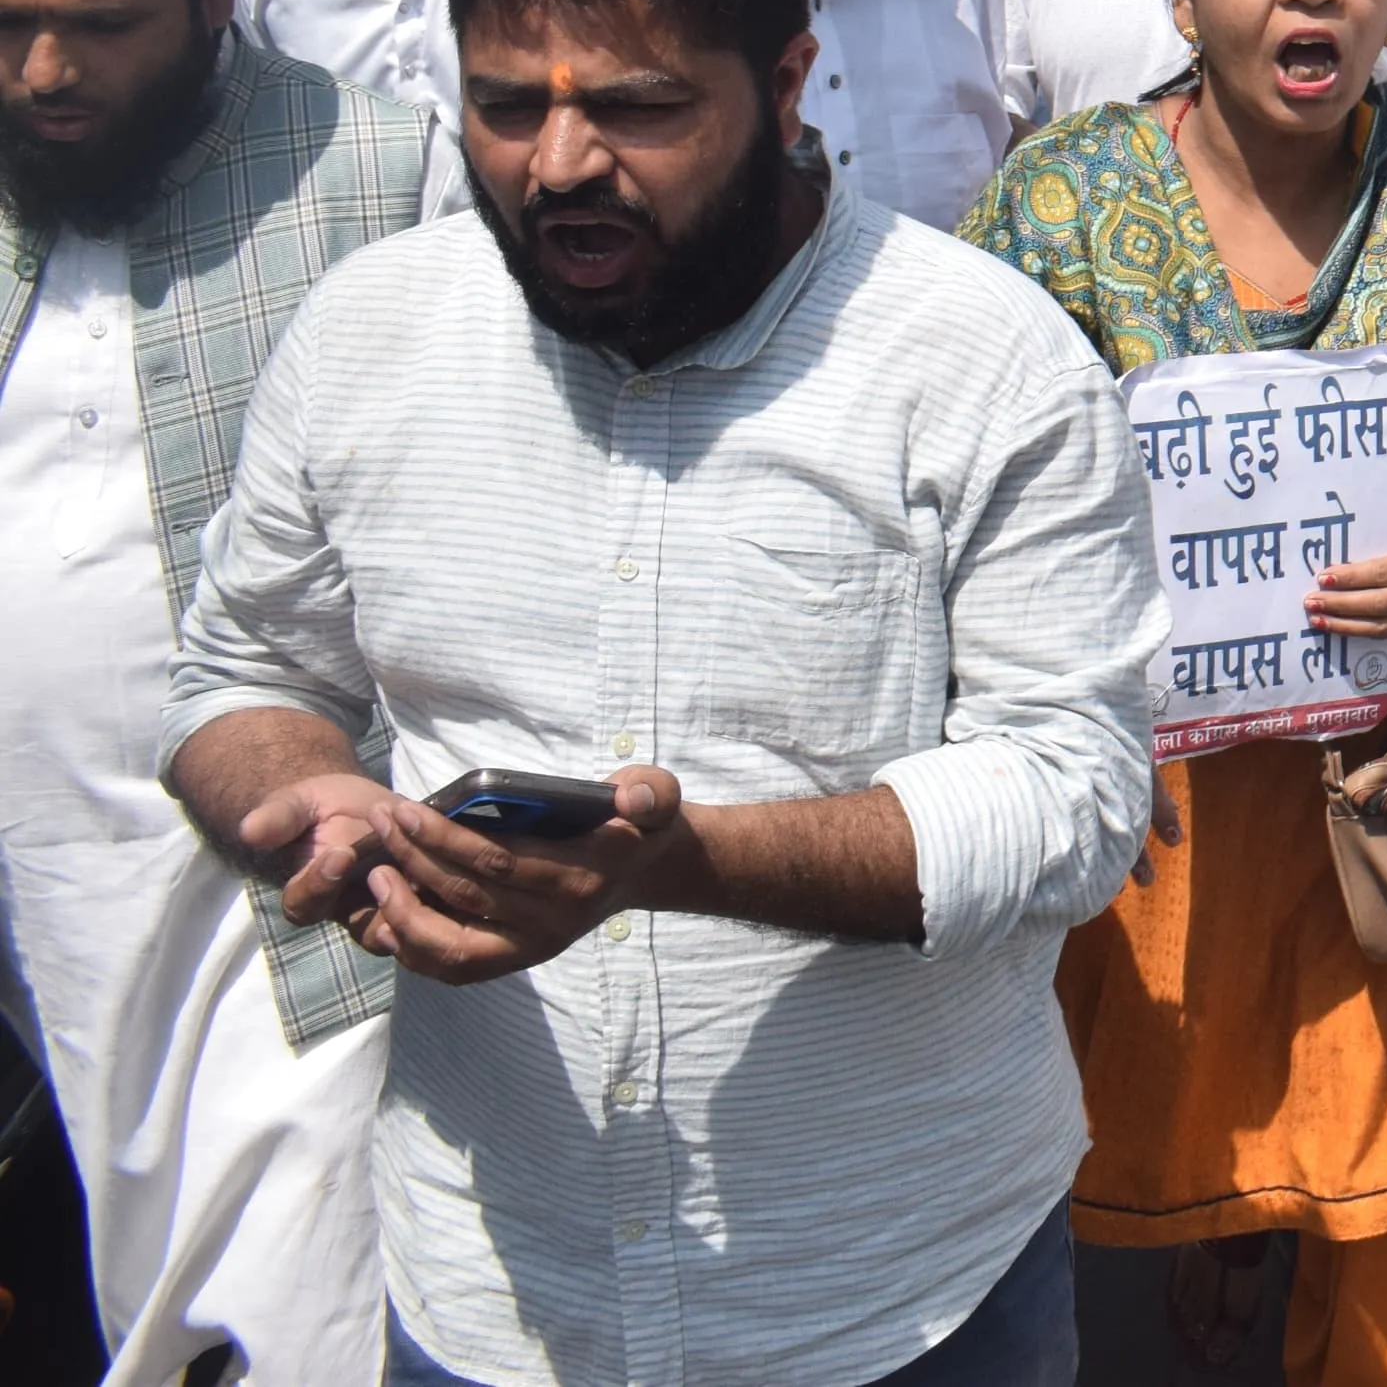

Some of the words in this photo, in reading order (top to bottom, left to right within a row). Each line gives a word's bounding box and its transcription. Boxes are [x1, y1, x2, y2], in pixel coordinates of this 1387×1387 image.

[1134, 390, 1213, 489] बढ़ी
[1224, 383, 1281, 499] हुई
[1170, 521, 1287, 589] वापस
[1300, 491, 1356, 577] लो
[1171, 632, 1288, 697] वापस
